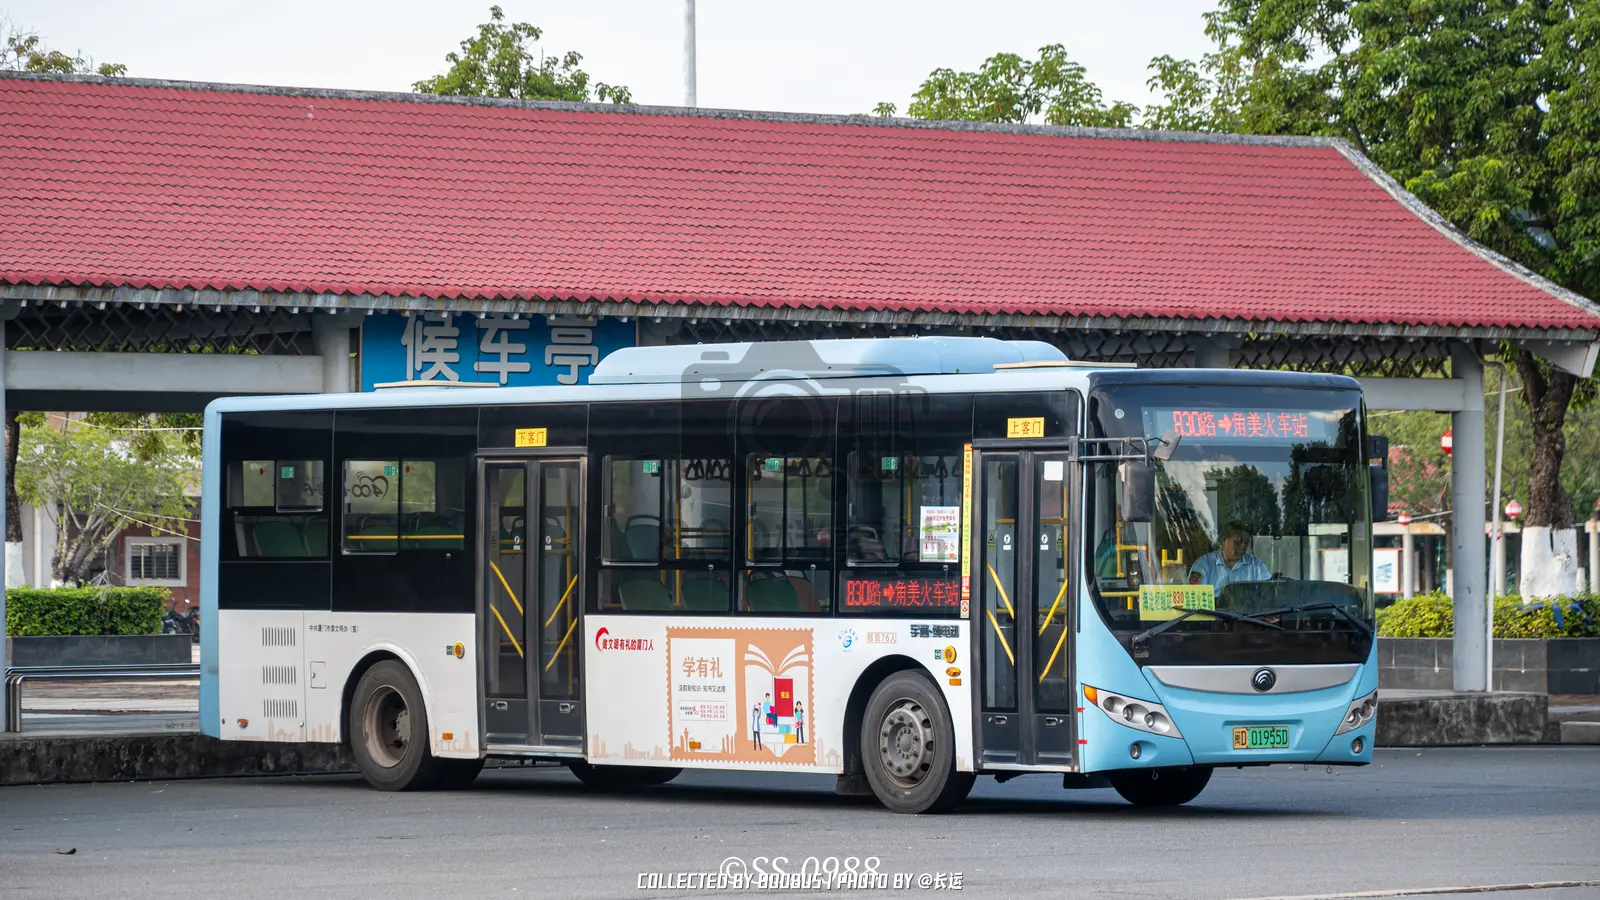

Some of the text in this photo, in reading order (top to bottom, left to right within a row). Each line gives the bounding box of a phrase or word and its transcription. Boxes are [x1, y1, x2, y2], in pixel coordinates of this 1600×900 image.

[401, 313, 599, 385] 候车亭
[1010, 420, 1041, 435] 上客门
[1173, 411, 1309, 438] 830路 角美火车站
[518, 431, 544, 444] 下客门
[846, 580, 881, 606] 830路
[893, 580, 960, 606] 角美火车站
[1172, 591, 1185, 604] 830
[682, 656, 723, 678] 学有礼
